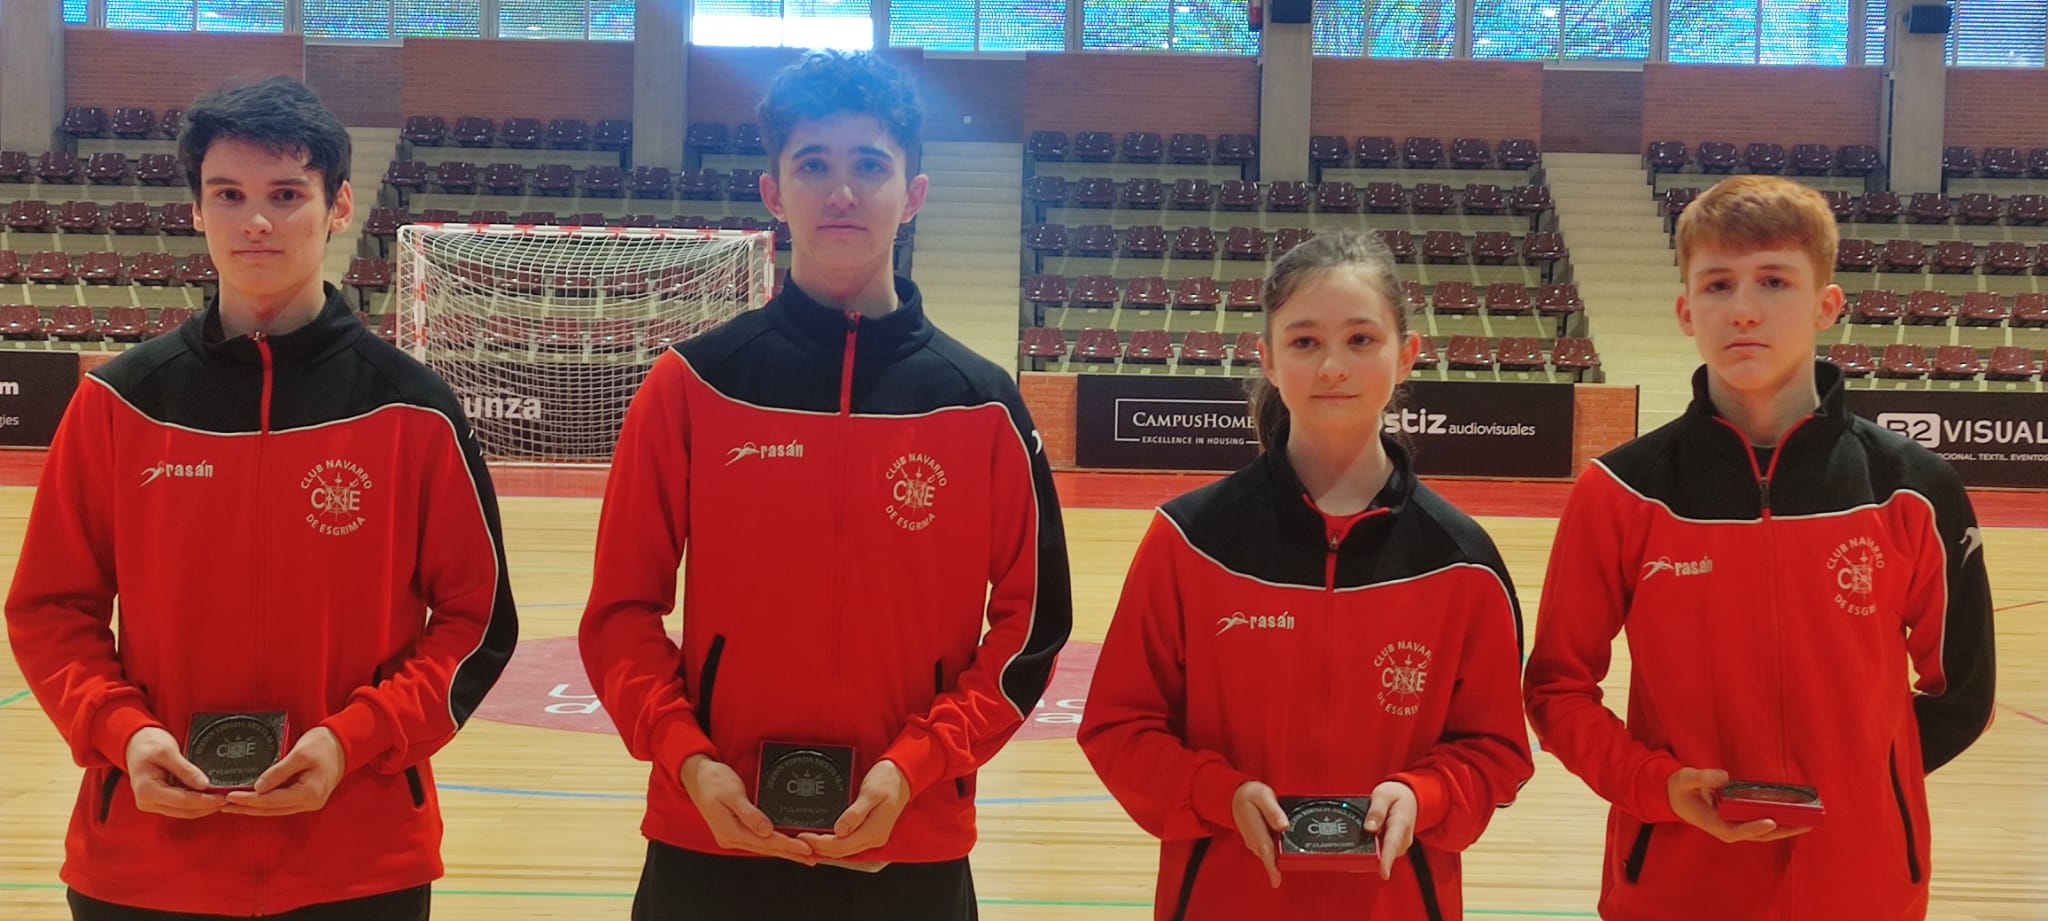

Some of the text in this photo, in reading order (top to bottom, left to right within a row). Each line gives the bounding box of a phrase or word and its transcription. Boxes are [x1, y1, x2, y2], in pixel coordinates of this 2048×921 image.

[1448, 421, 1536, 436] audiovisuales
[1943, 419, 2048, 444] VISUAL
[760, 439, 804, 459] rasán
[1141, 435, 1245, 446] EXCELLENCE IN HOUSING
[165, 459, 214, 478] rasán
[300, 459, 373, 490] CLUB NAVARRO
[885, 453, 948, 487] CLUB NAVARRO
[885, 504, 898, 520] DE
[305, 513, 366, 536] DE ESGRIMA
[1249, 610, 1295, 630] rasán
[1373, 643, 1395, 667] CLUB
